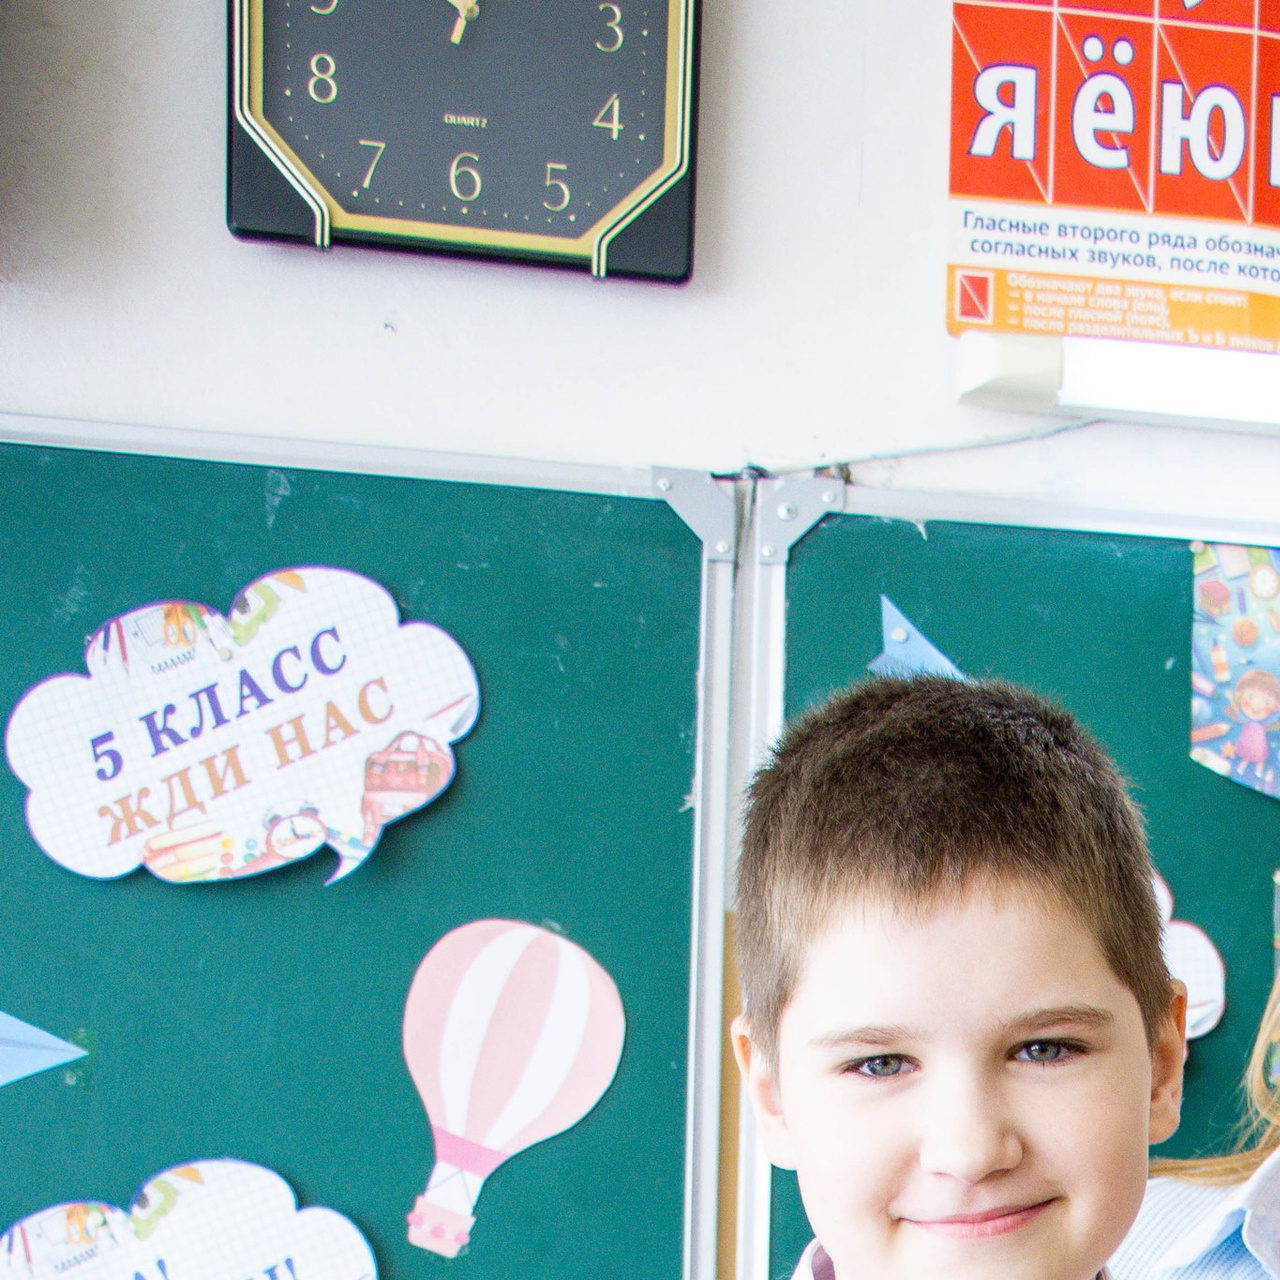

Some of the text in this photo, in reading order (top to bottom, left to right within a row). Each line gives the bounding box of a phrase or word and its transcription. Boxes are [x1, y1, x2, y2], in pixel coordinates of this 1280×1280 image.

[596, 3, 624, 52] 3
[308, 53, 338, 103] 8
[444, 113, 488, 129] QUARTZ
[592, 92, 624, 141] 4
[359, 139, 387, 189] 7
[449, 152, 482, 202] 6
[543, 162, 571, 212] 5
[963, 210, 1050, 237] Гласные
[1057, 222, 1141, 245] второго
[1148, 231, 1197, 253] ряда
[970, 237, 1080, 263] согласных
[1087, 246, 1162, 271] звуков,
[1169, 254, 1230, 276] после
[90, 625, 348, 782] 5 КЛАСС
[97, 676, 395, 848] ЖДИ НАС
